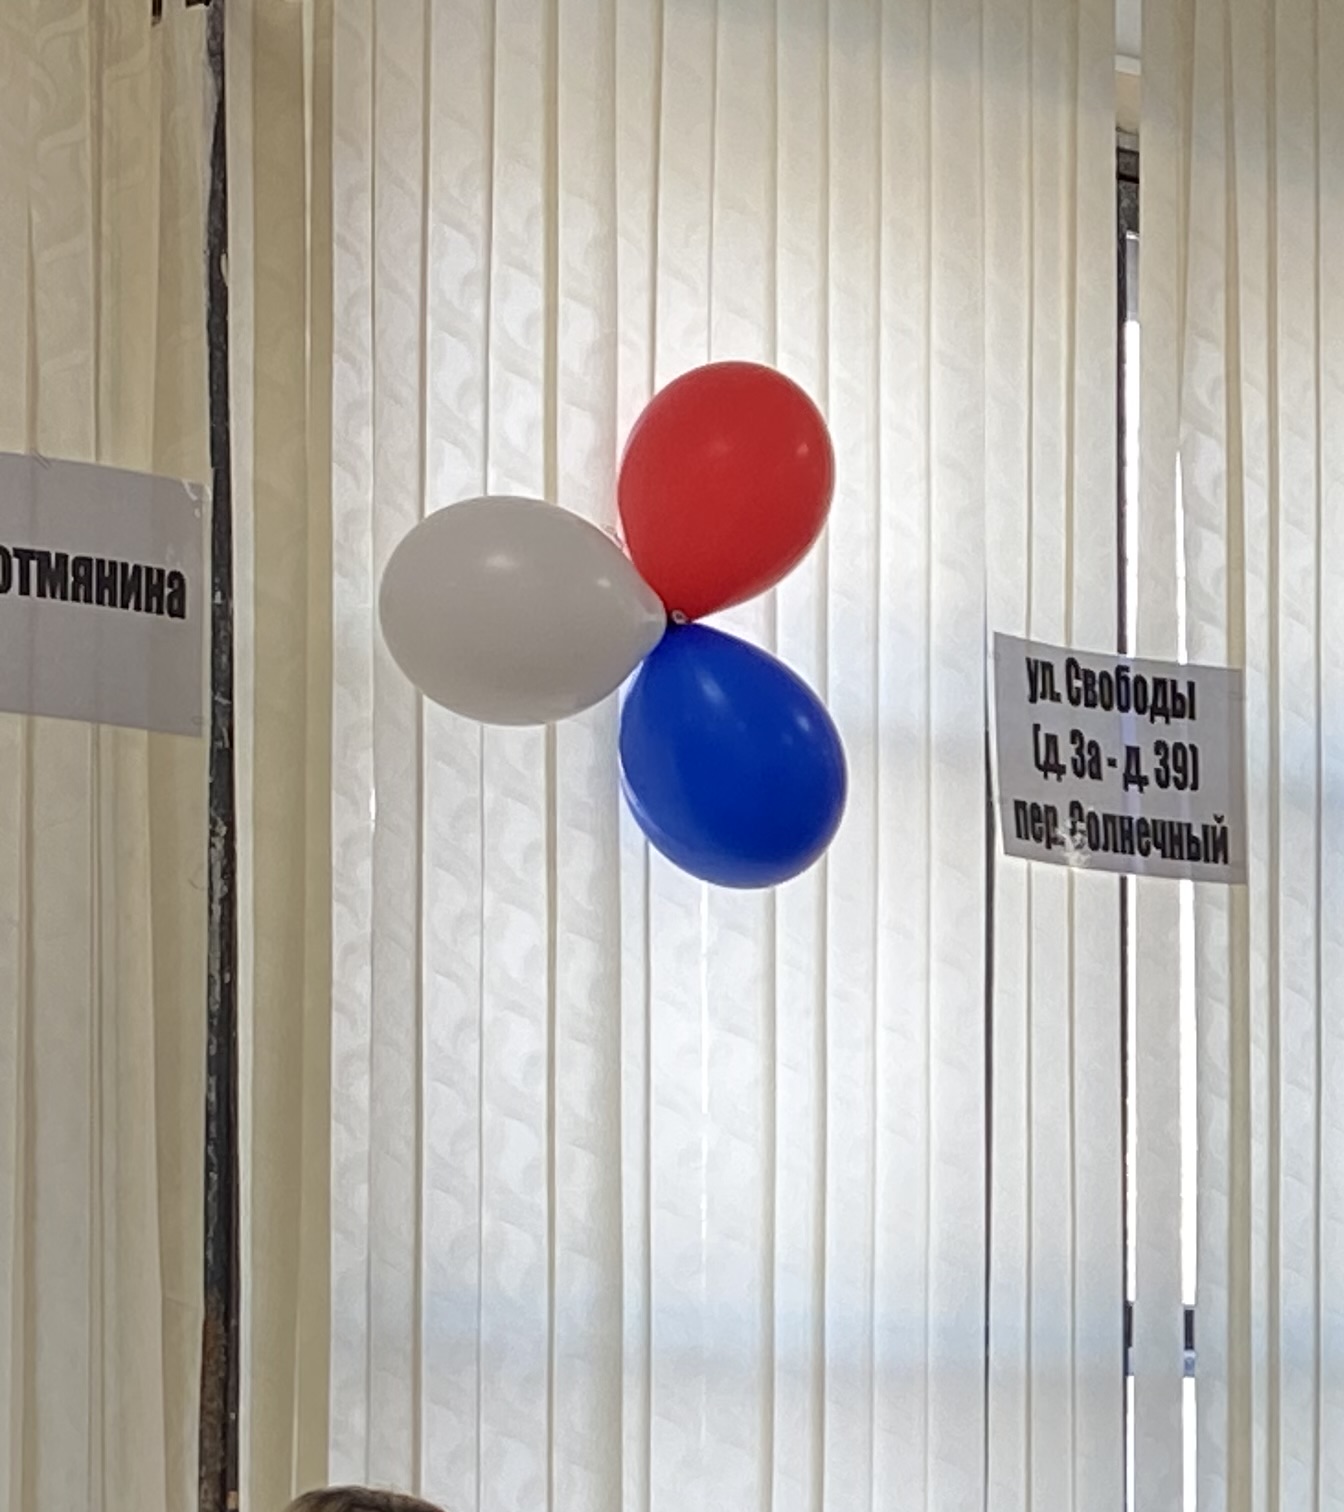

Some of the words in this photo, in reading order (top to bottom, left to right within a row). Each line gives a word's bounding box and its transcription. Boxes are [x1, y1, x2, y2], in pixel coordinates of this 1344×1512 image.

[1025, 656, 1062, 704] ул.
[1065, 657, 1197, 725] Свободы
[1153, 739, 1199, 791] 39)
[1014, 799, 1065, 850] пер.
[1068, 800, 1230, 865] Солнечный
